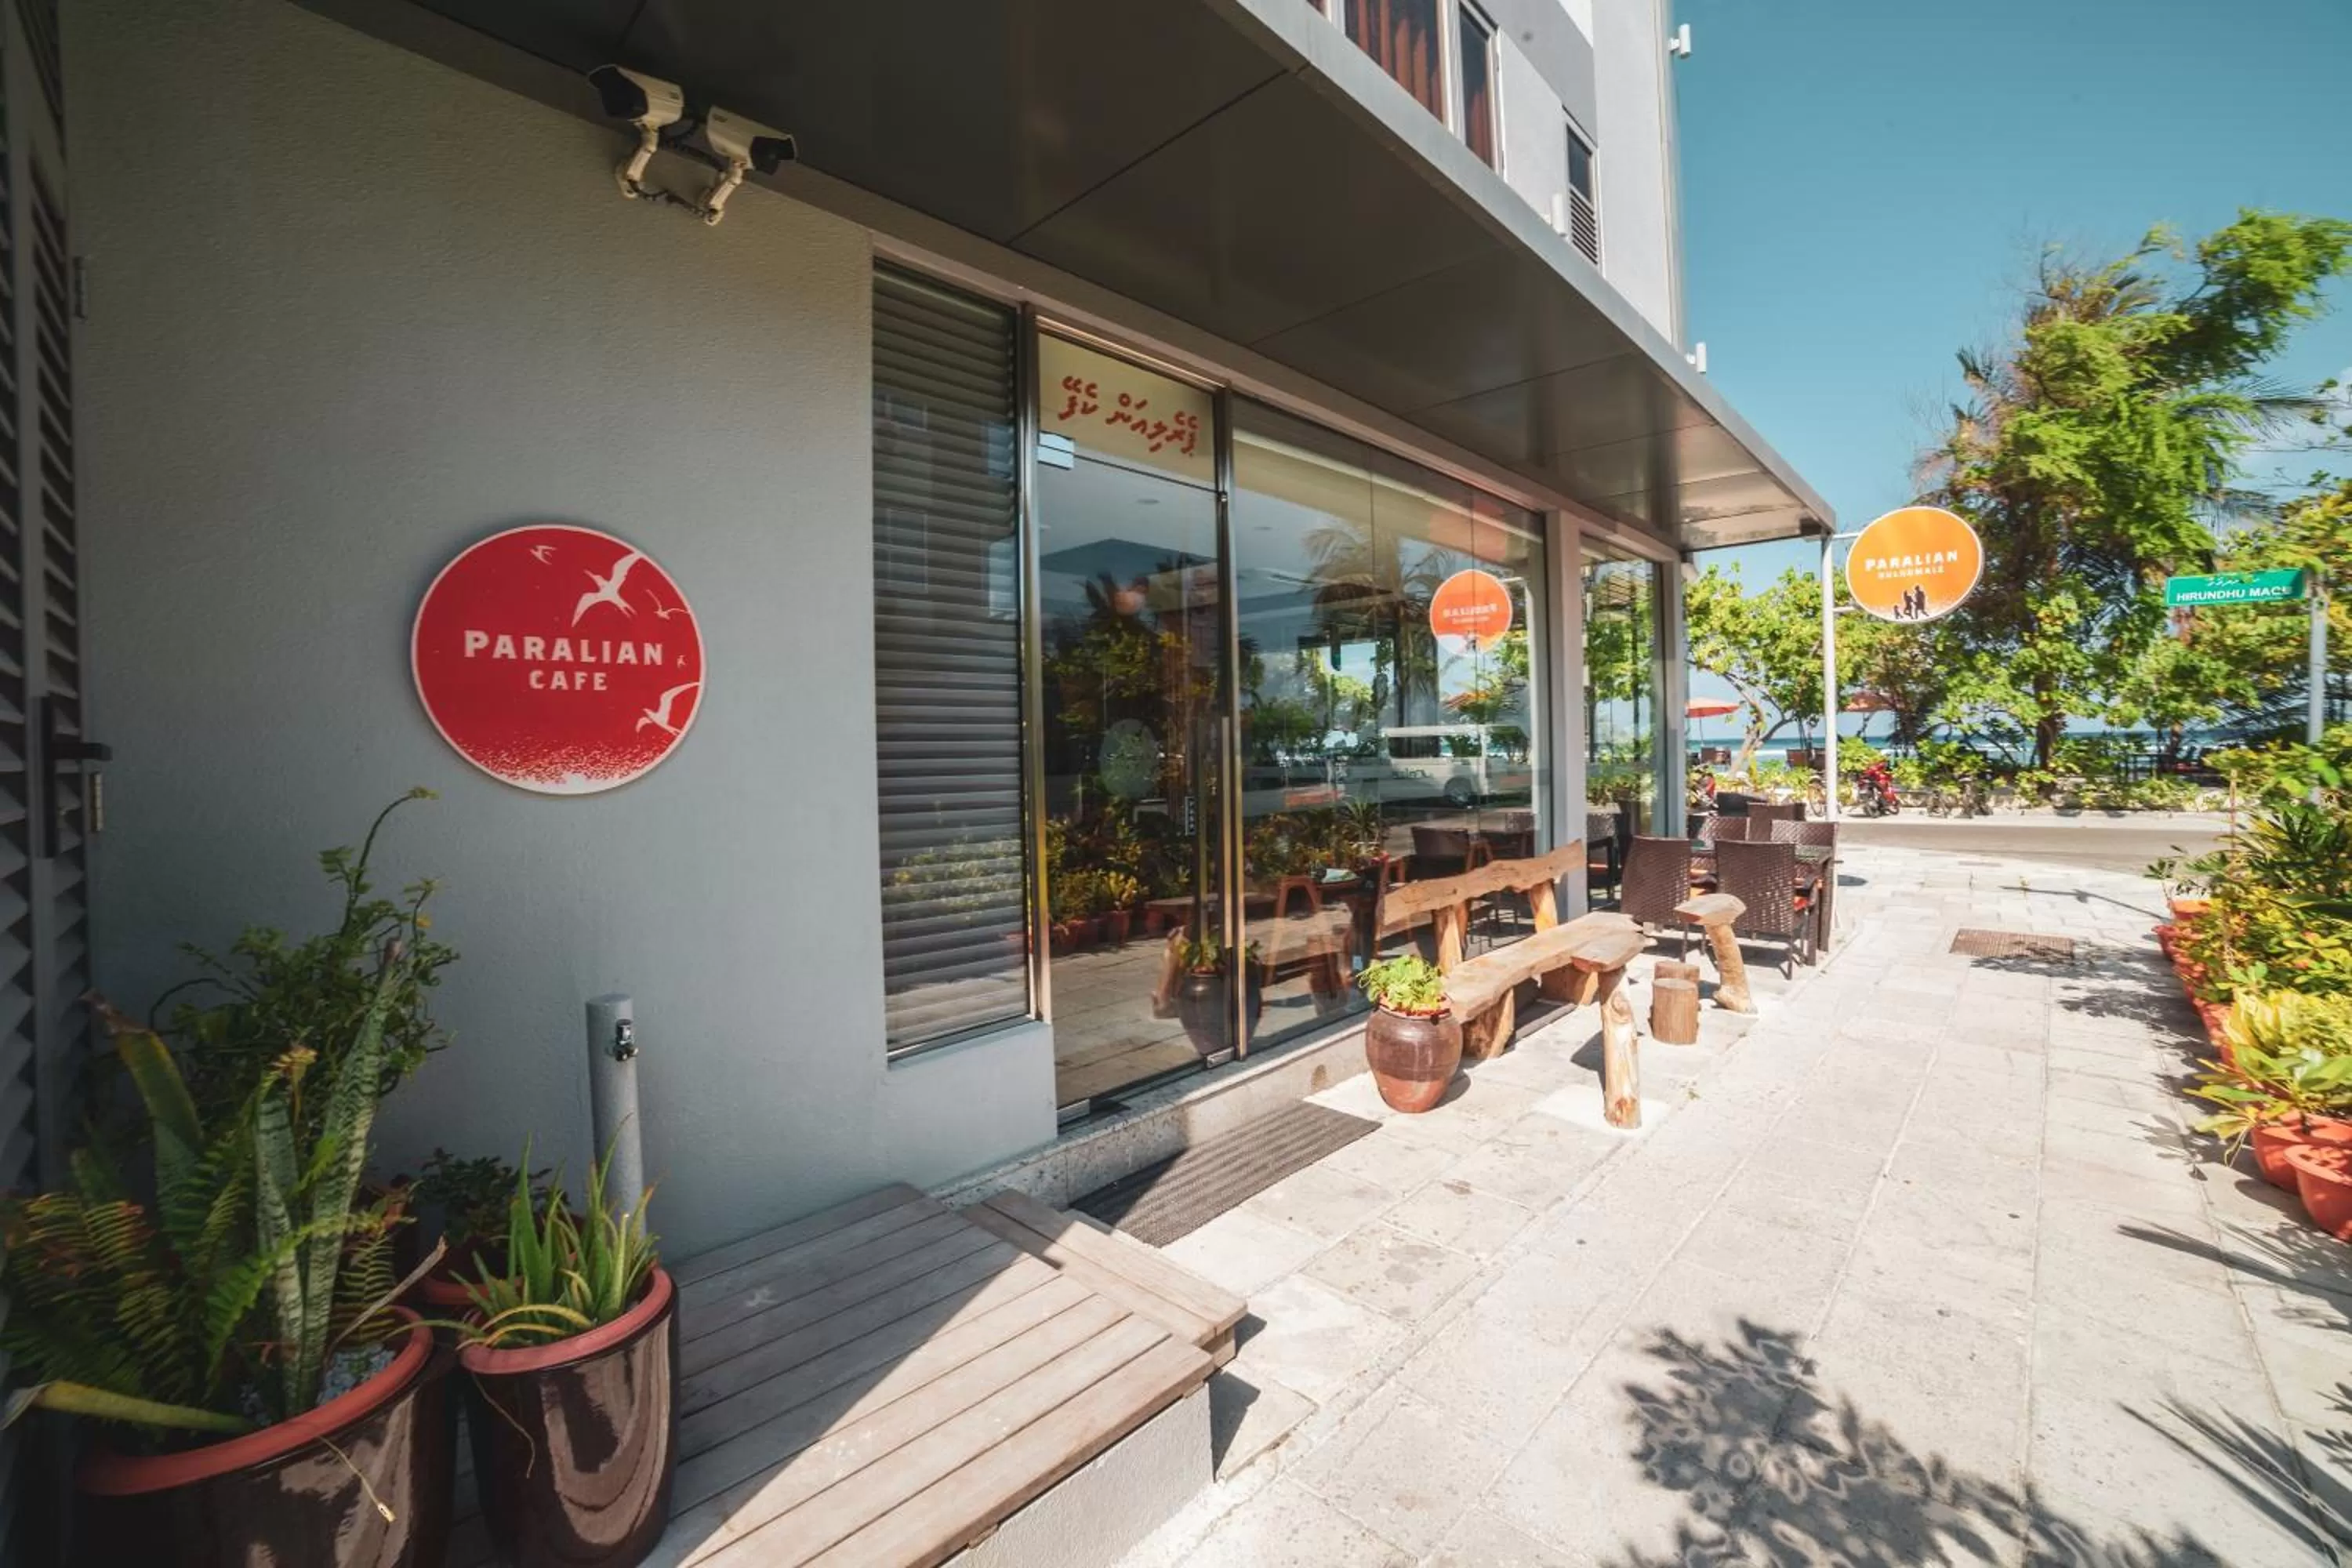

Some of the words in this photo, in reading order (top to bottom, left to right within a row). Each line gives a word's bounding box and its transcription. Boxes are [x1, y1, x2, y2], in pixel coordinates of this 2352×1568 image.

[1865, 550, 1958, 572] PARALIAN
[2176, 589, 2246, 602] HIRUNDHU
[464, 630, 663, 666] PARALIAN
[529, 670, 608, 691] CAFE
